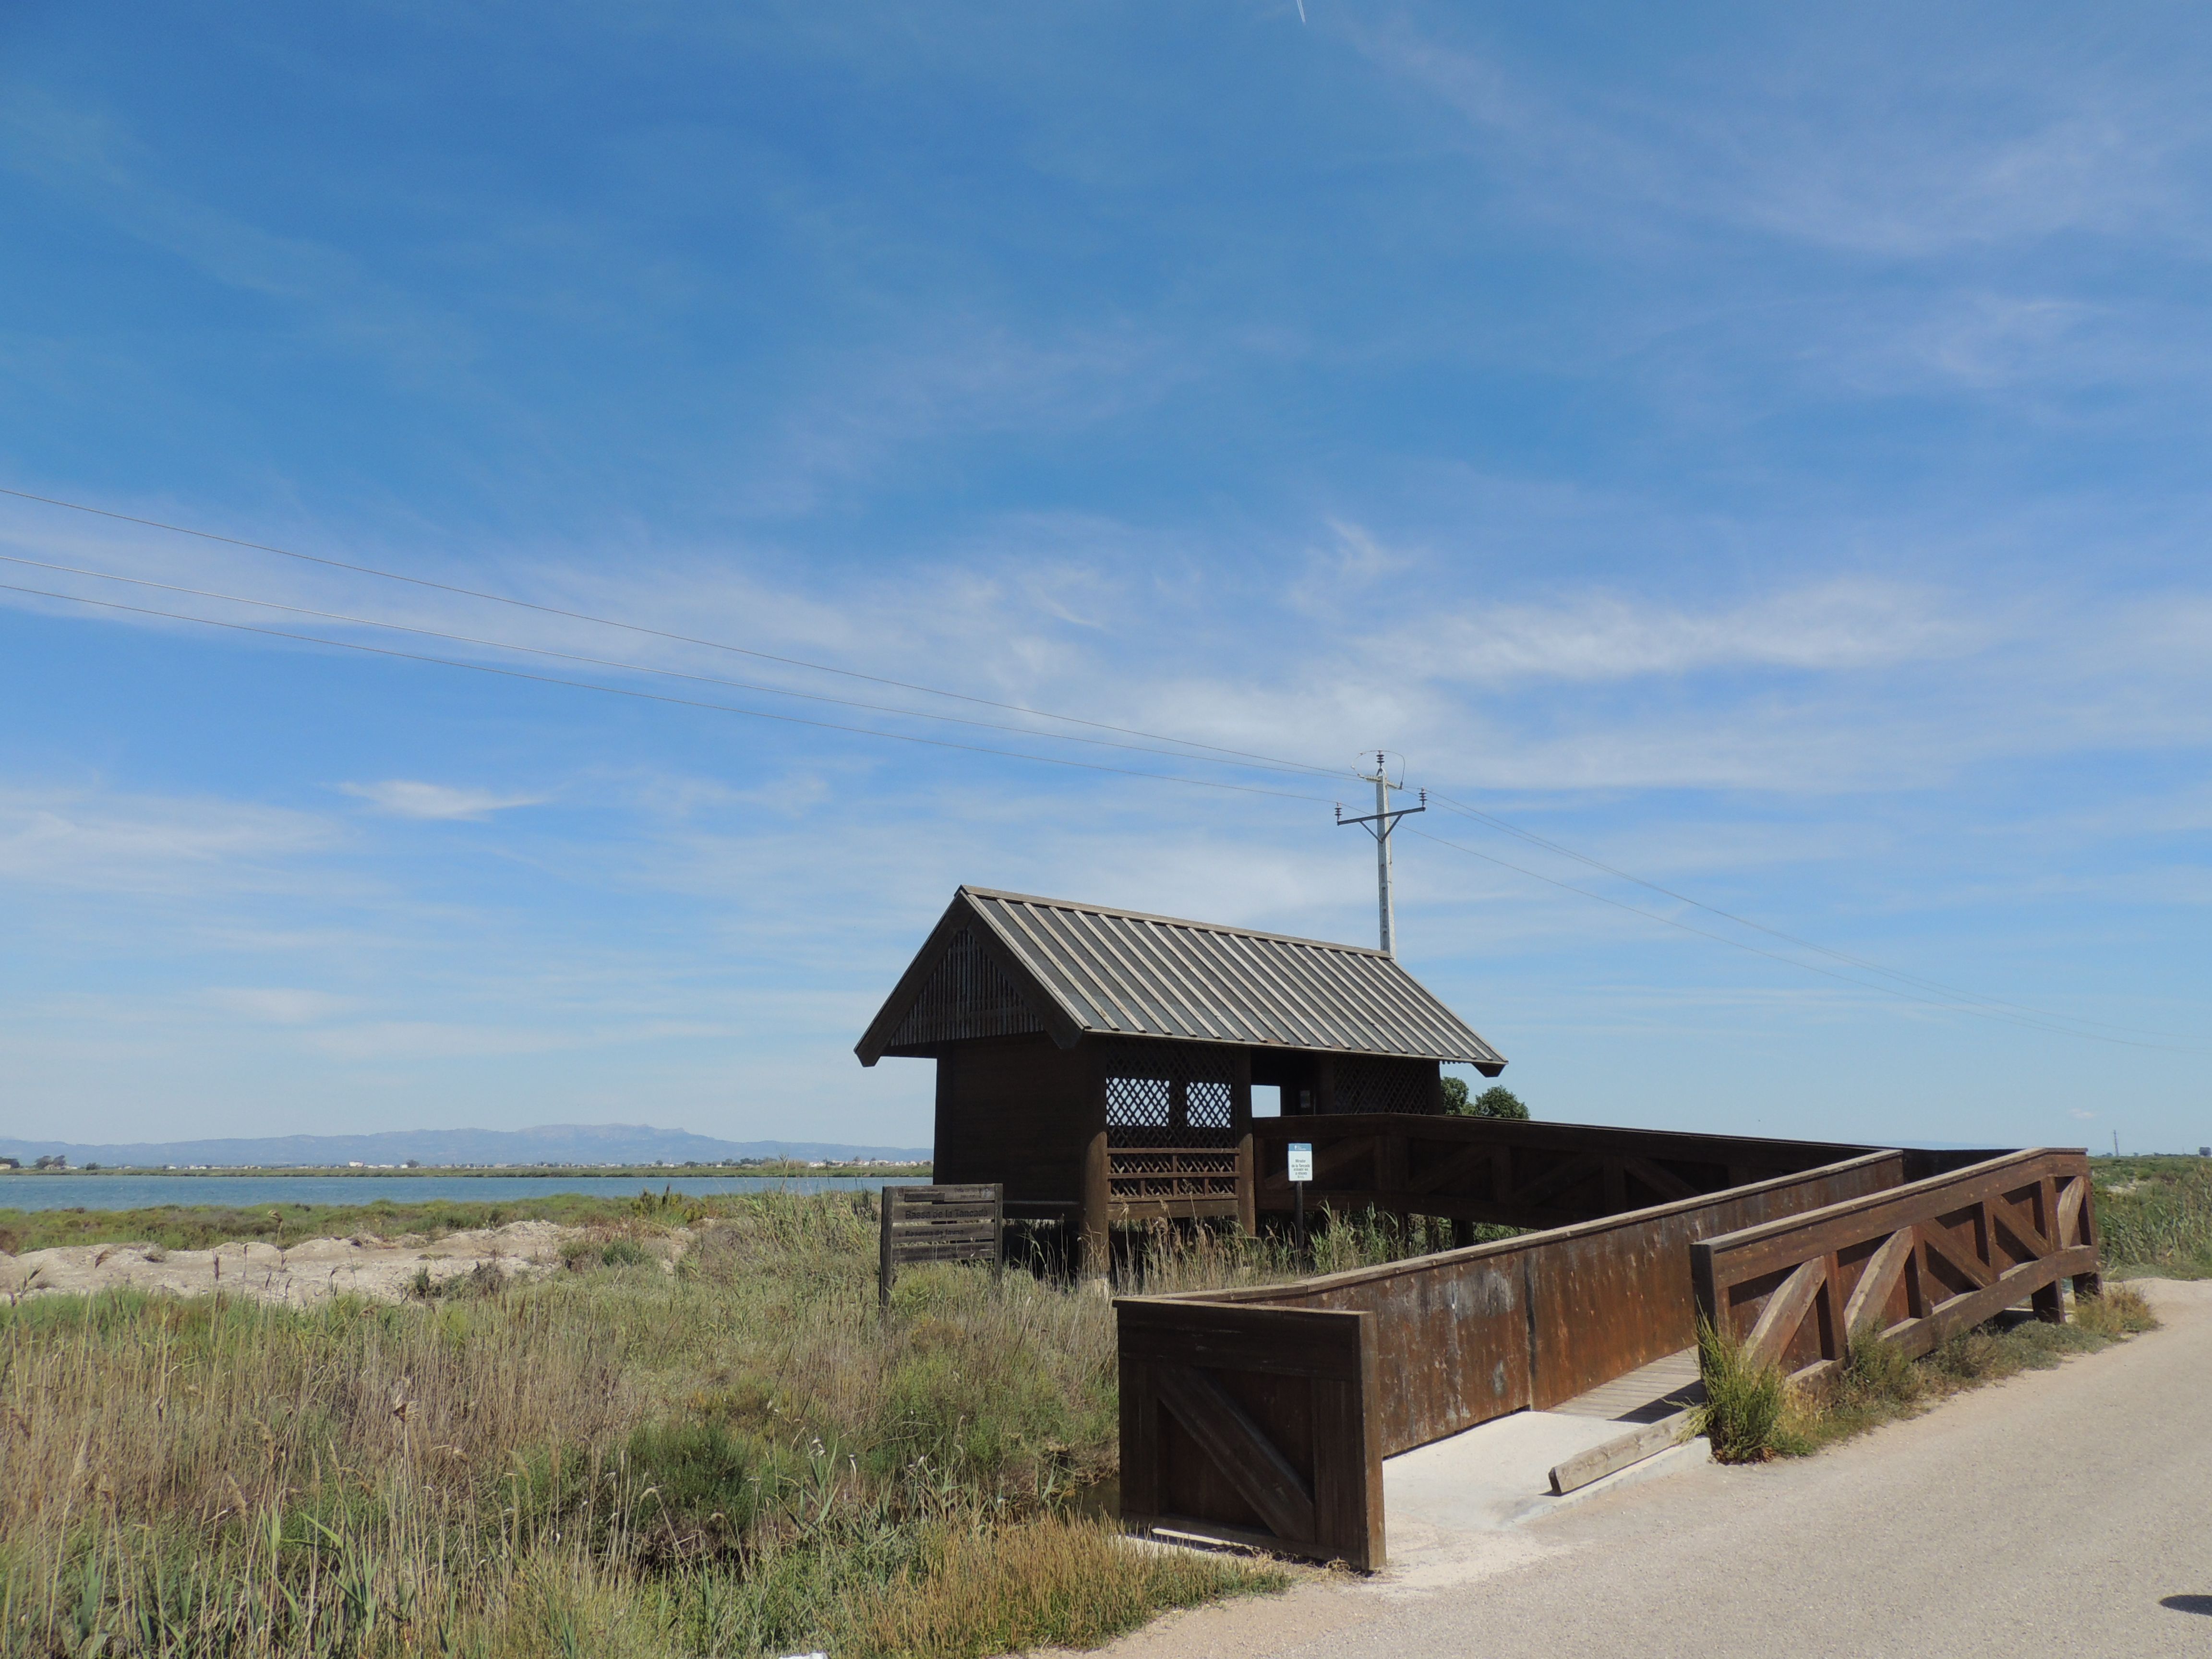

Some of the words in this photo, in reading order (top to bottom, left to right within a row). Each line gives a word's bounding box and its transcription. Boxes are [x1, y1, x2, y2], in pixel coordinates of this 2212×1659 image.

[905, 1210, 930, 1219] Bassa
[933, 1210, 942, 1218] de
[946, 1209, 952, 1218] la
[955, 1208, 987, 1217] Tancada
